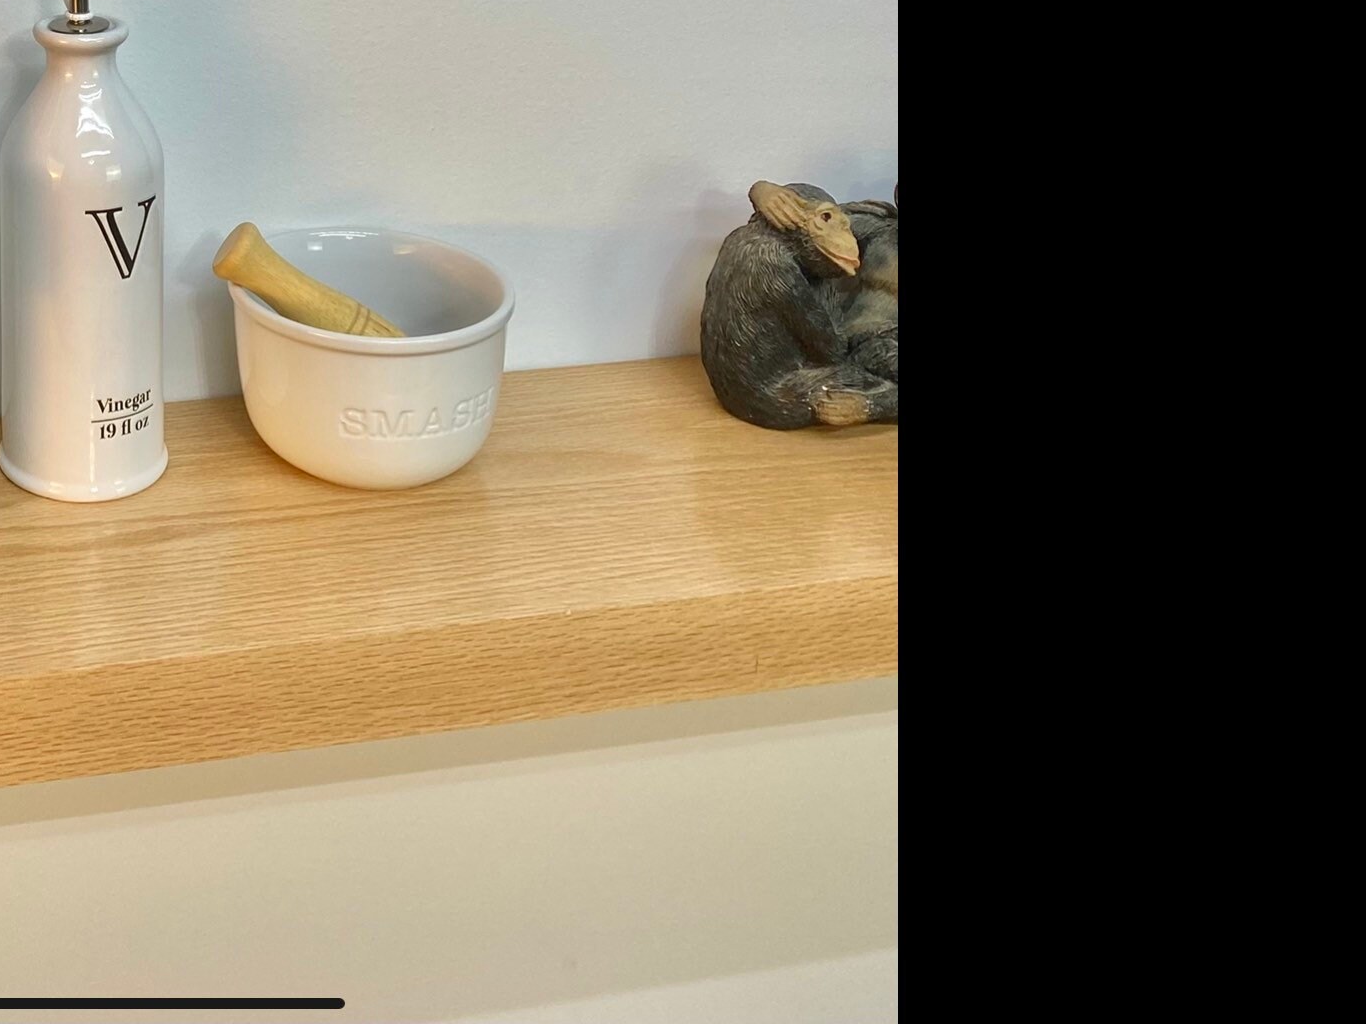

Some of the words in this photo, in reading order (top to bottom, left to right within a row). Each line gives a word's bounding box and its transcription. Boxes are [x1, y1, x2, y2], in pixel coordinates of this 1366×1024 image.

[85, 194, 156, 279] V
[96, 388, 151, 414] Vinegar
[338, 386, 495, 439] SMASH
[99, 422, 116, 439] 19
[121, 418, 132, 435] fl
[135, 415, 149, 431] oz
